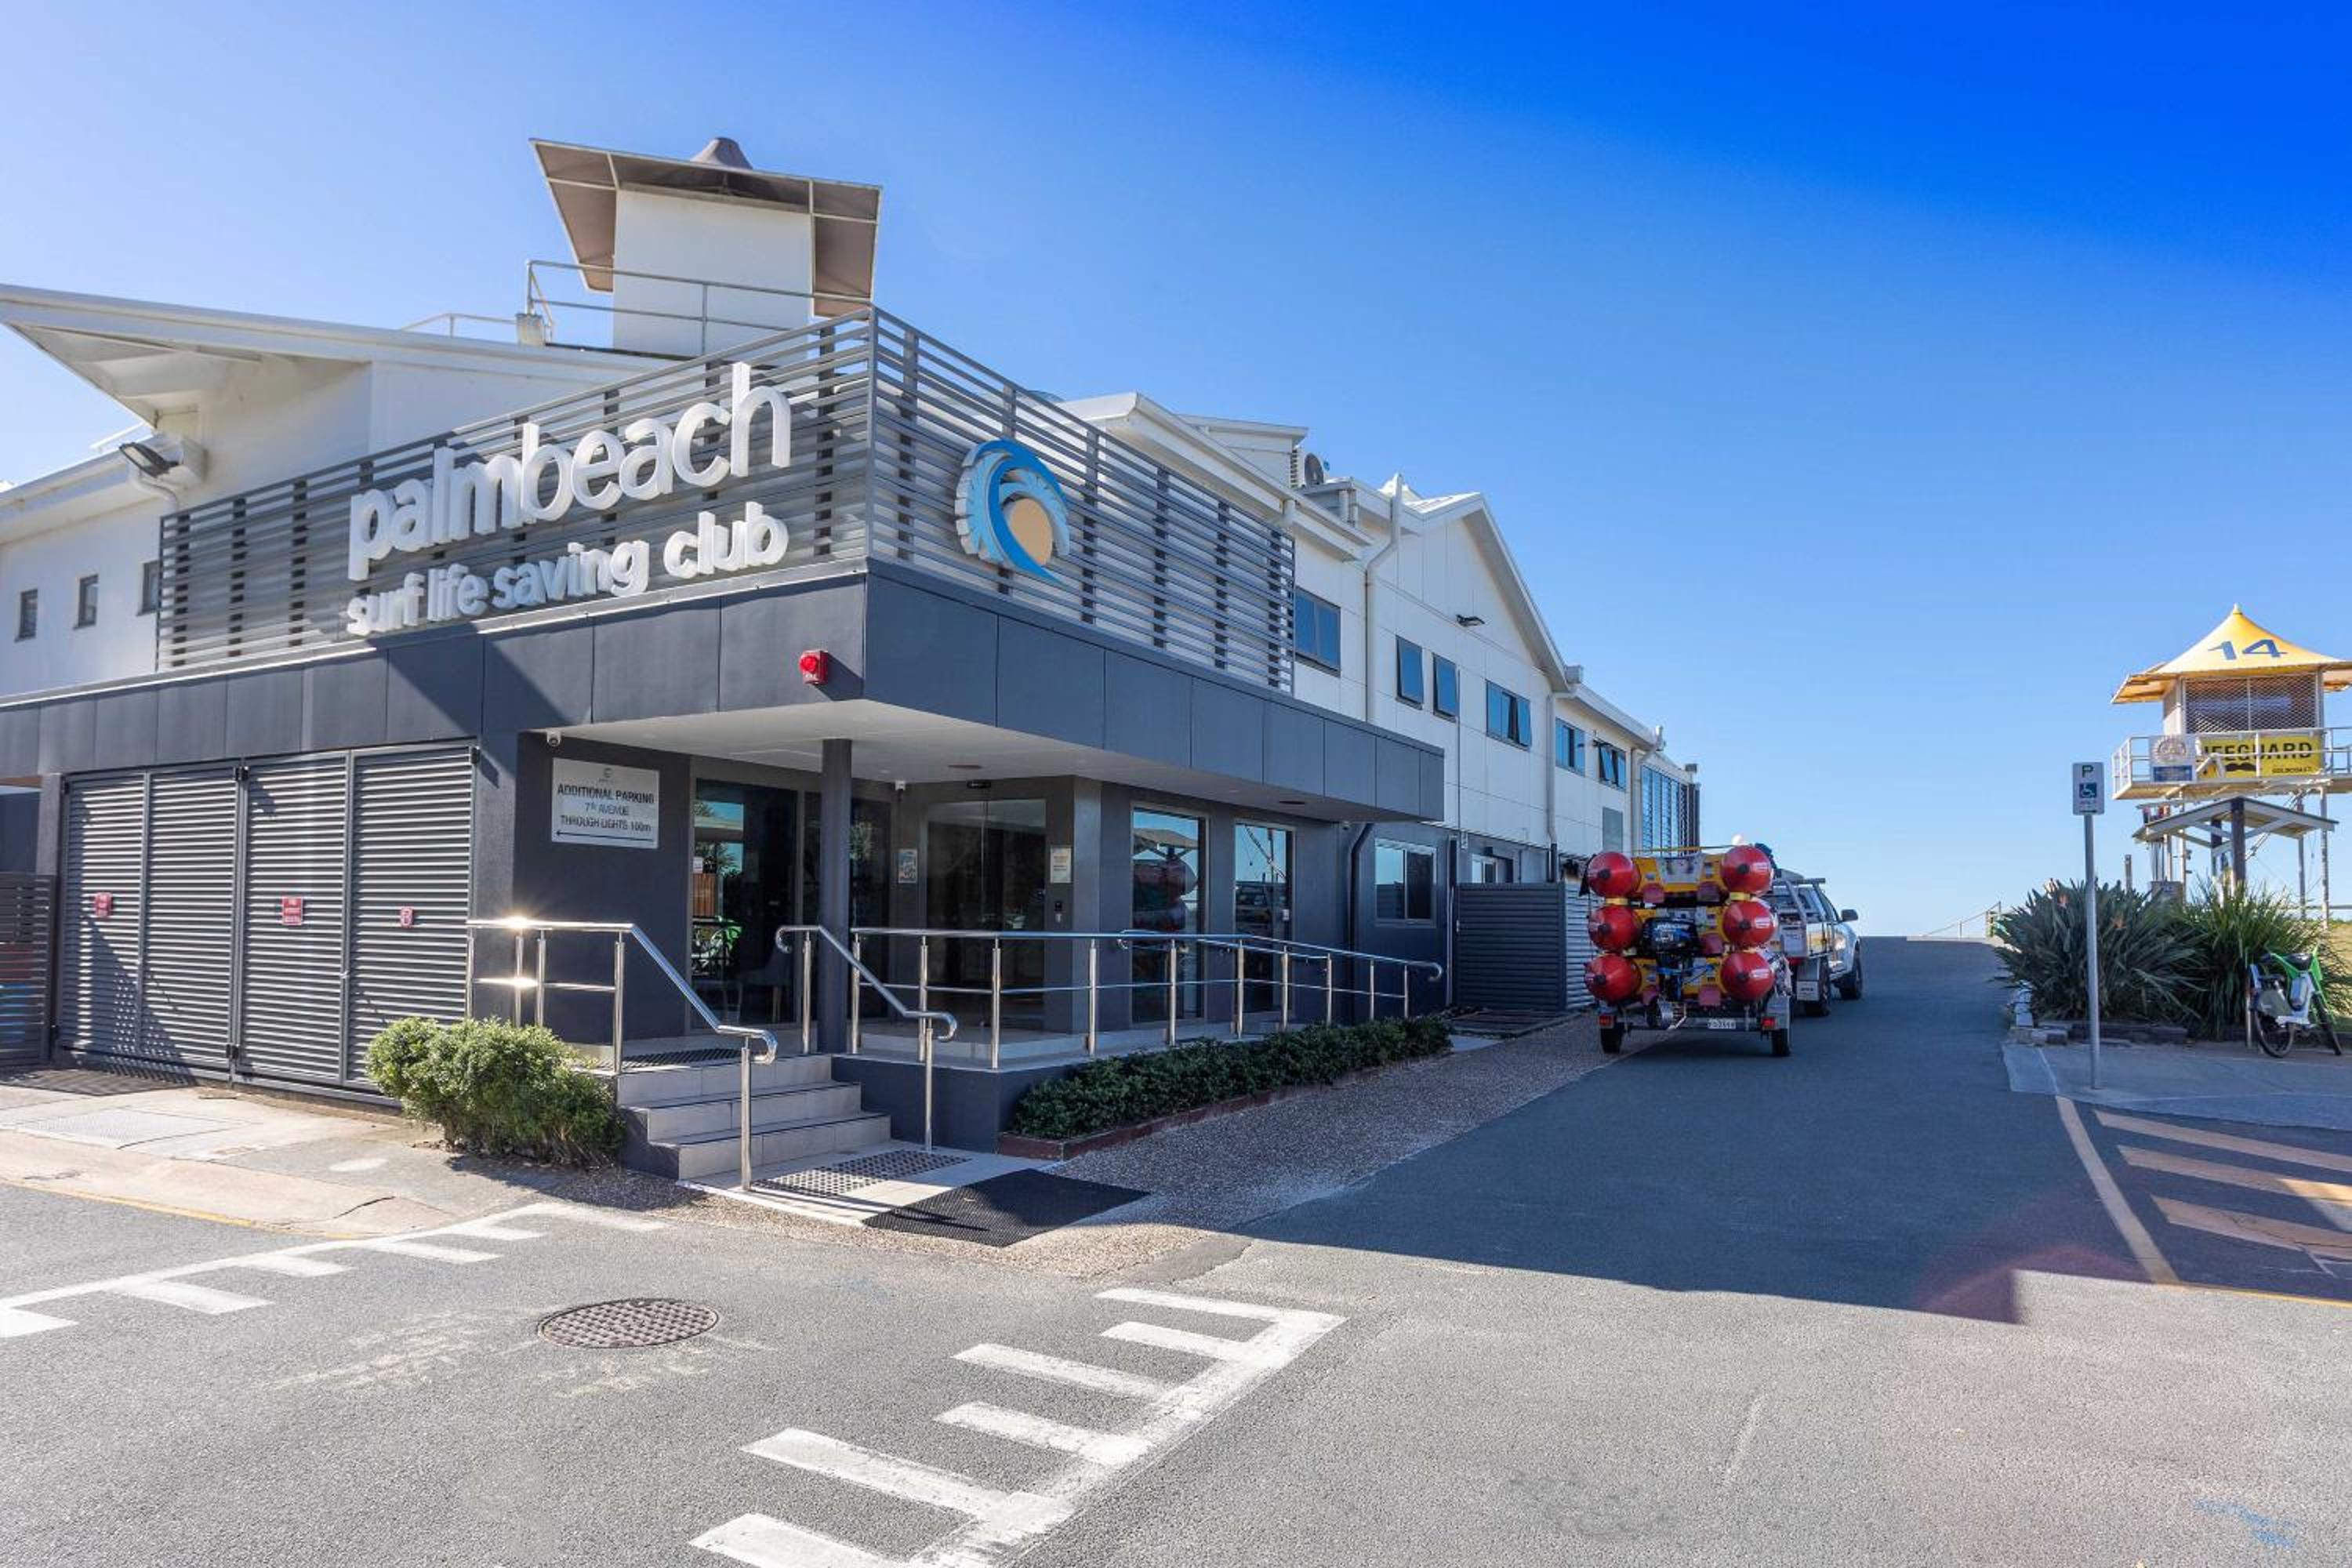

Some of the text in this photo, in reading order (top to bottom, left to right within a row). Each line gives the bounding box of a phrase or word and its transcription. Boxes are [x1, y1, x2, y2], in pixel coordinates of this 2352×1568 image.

[347, 361, 792, 581] palmbeach
[346, 501, 789, 636] surf life saving club
[2208, 639, 2288, 660] 14
[2198, 742, 2312, 760] IFEGUARD
[2082, 764, 2094, 778] P
[557, 782, 655, 804] ADDITIONAL PARKING
[561, 815, 600, 827] THROUGH
